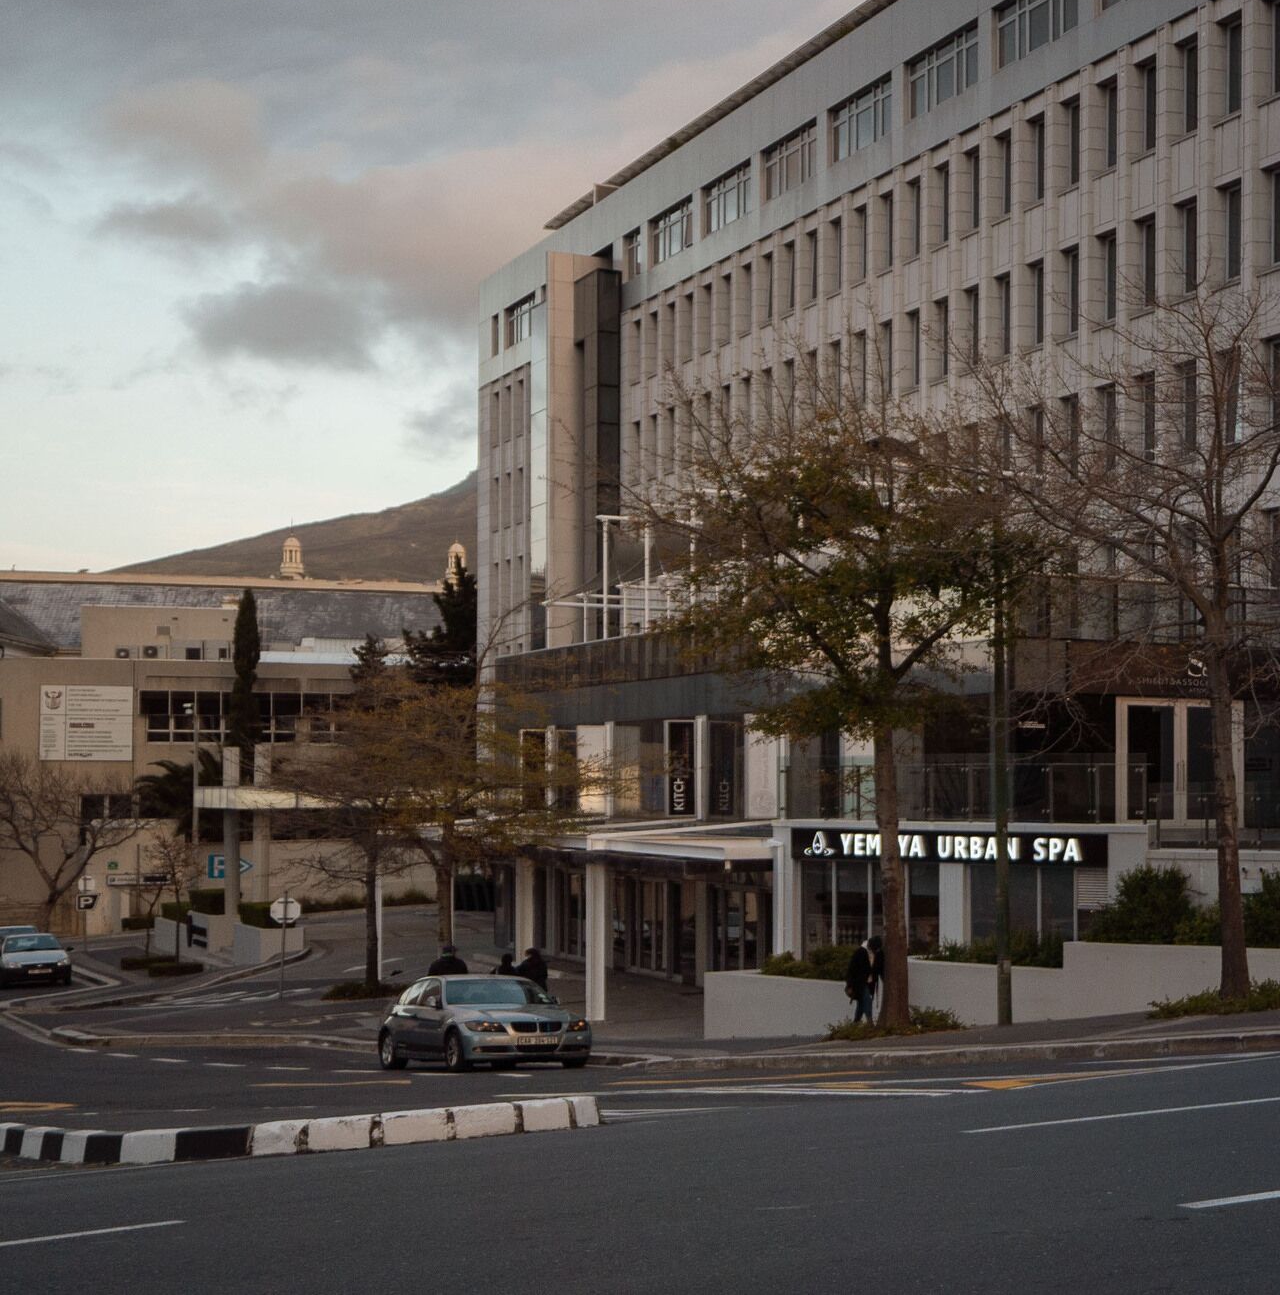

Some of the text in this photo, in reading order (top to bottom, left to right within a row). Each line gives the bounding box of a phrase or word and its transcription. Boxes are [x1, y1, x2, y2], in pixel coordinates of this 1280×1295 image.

[840, 833, 1083, 862] YEMYA URBAN SPA
